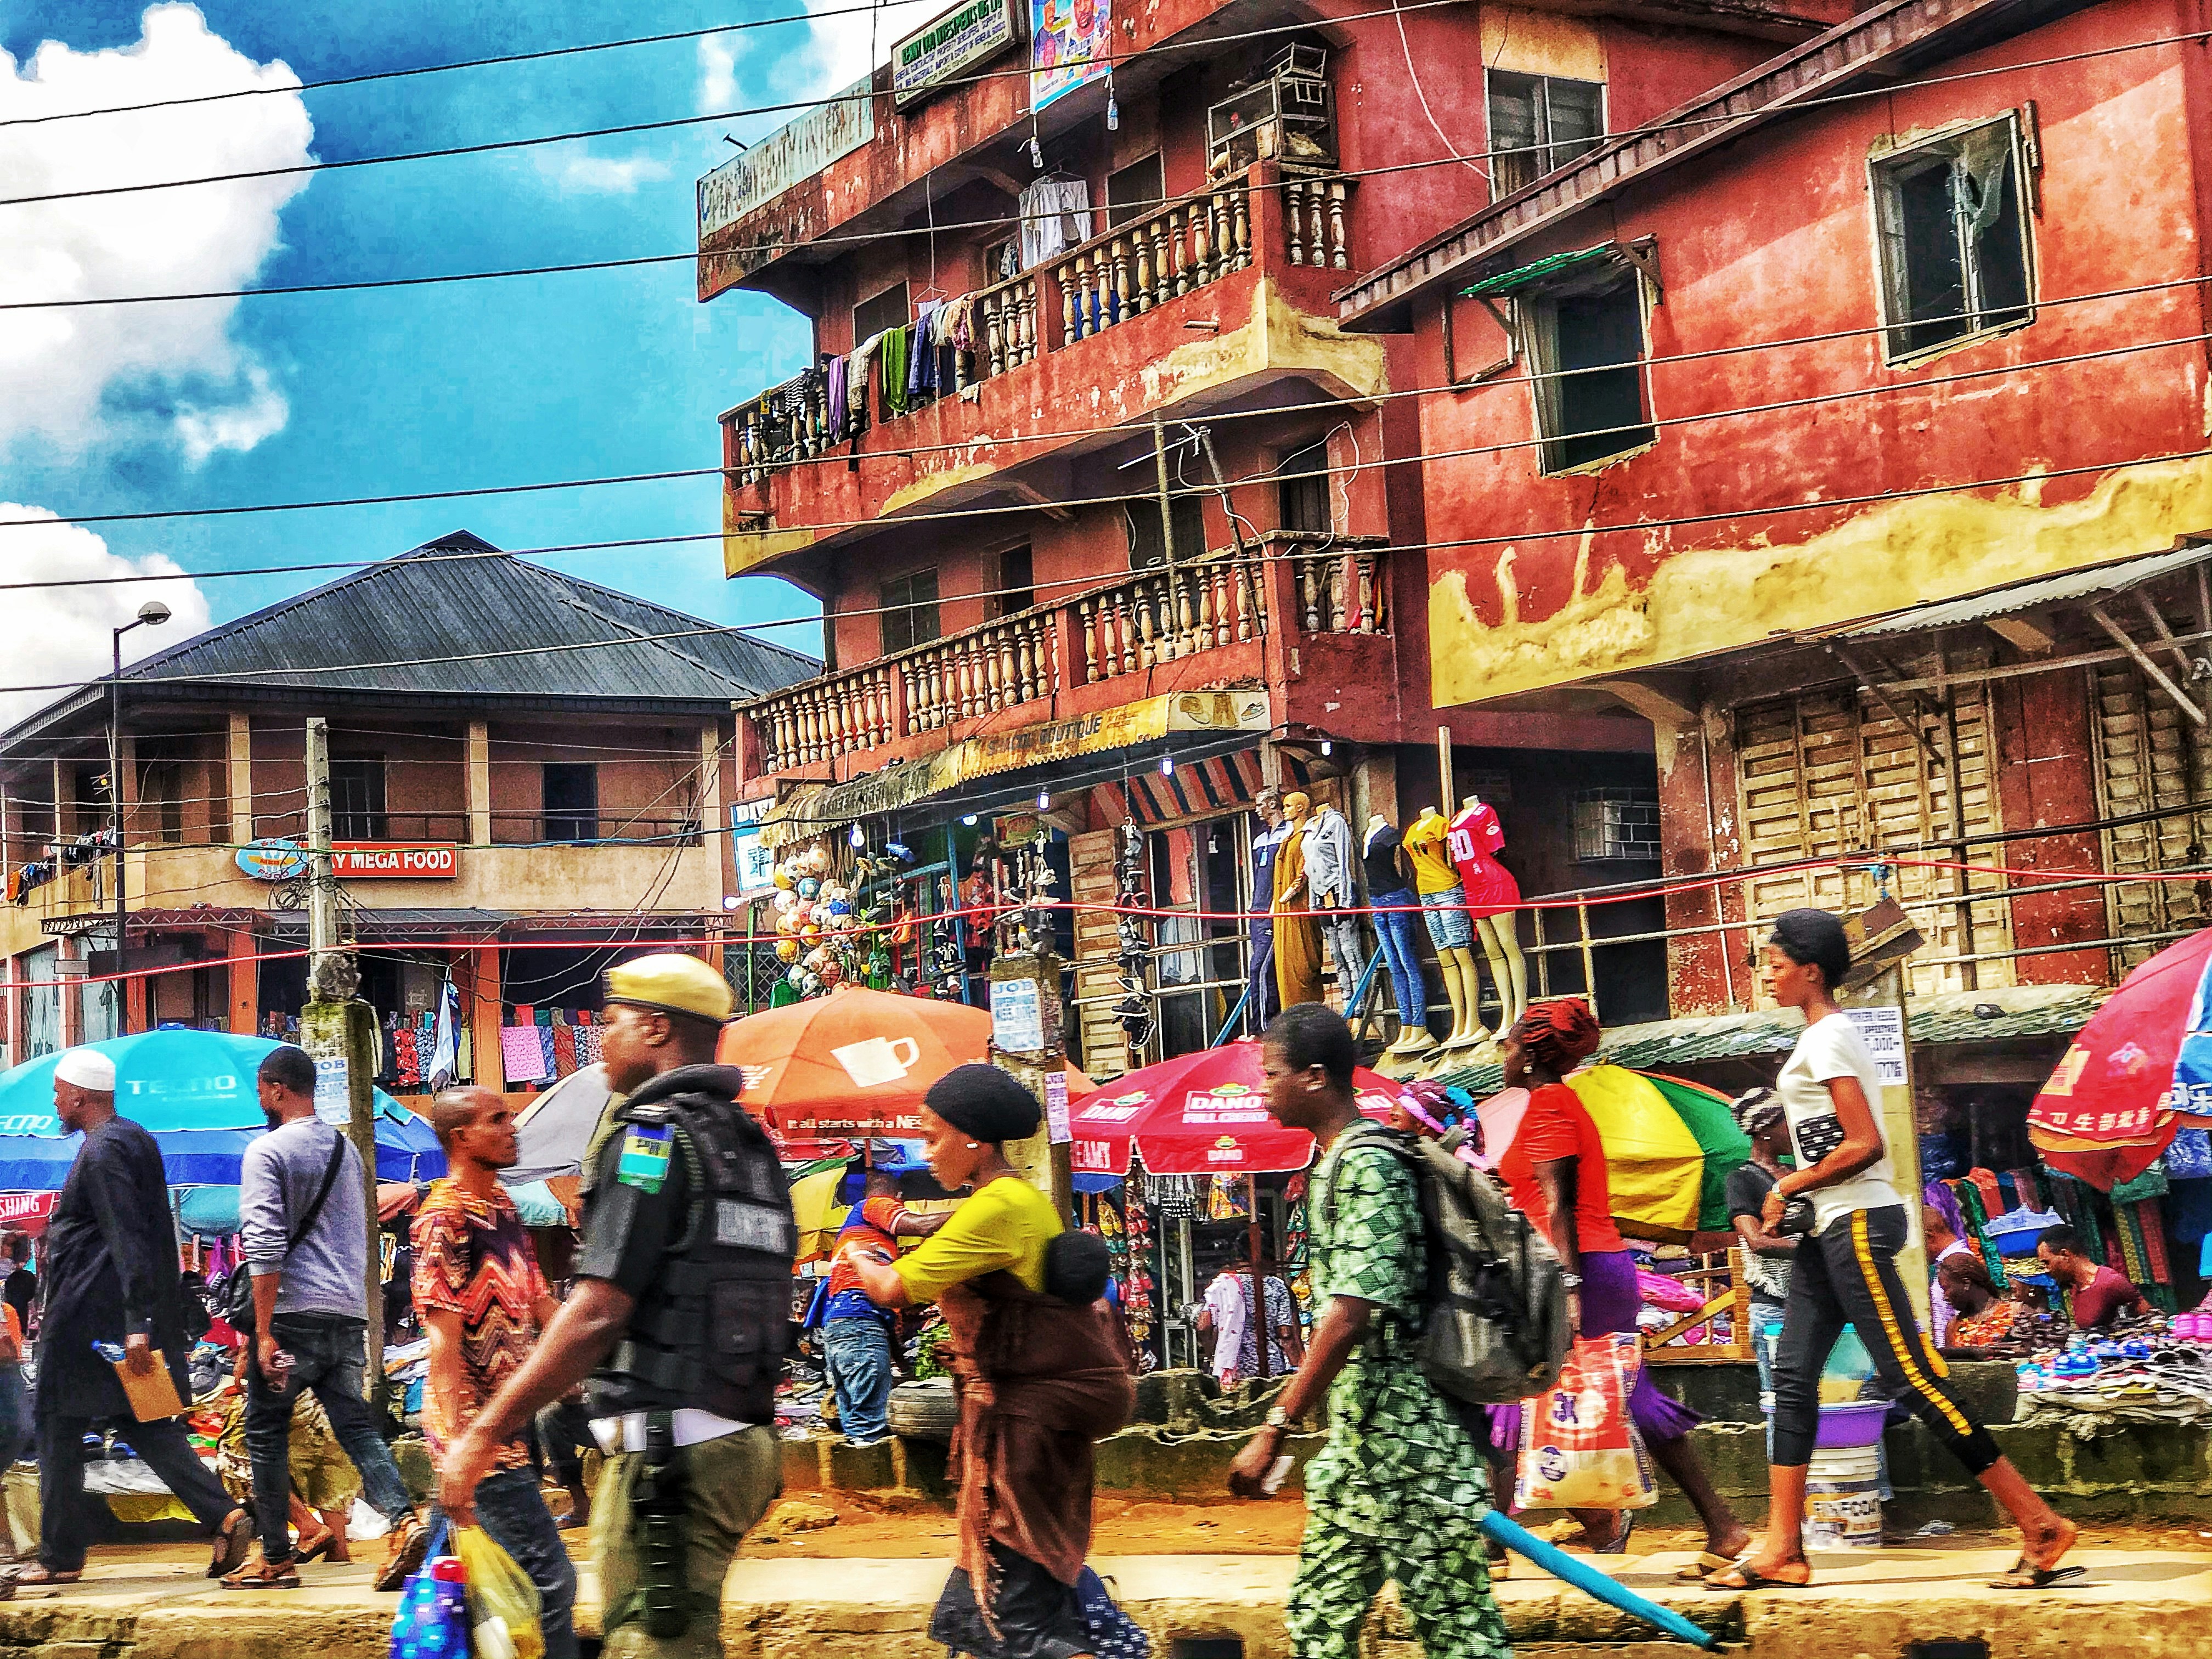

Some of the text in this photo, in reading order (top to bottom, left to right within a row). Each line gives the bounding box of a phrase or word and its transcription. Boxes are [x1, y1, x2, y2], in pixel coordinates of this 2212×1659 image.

[351, 853, 399, 868] MEGA
[404, 850, 452, 869] FOOD
[993, 981, 1034, 994] JOB
[126, 1075, 236, 1094] TECNO
[1192, 1096, 1262, 1109] DANO
[1081, 1105, 1139, 1120] DANO
[799, 1118, 816, 1128] all
[819, 1119, 854, 1128] starts
[856, 1118, 884, 1128] with
